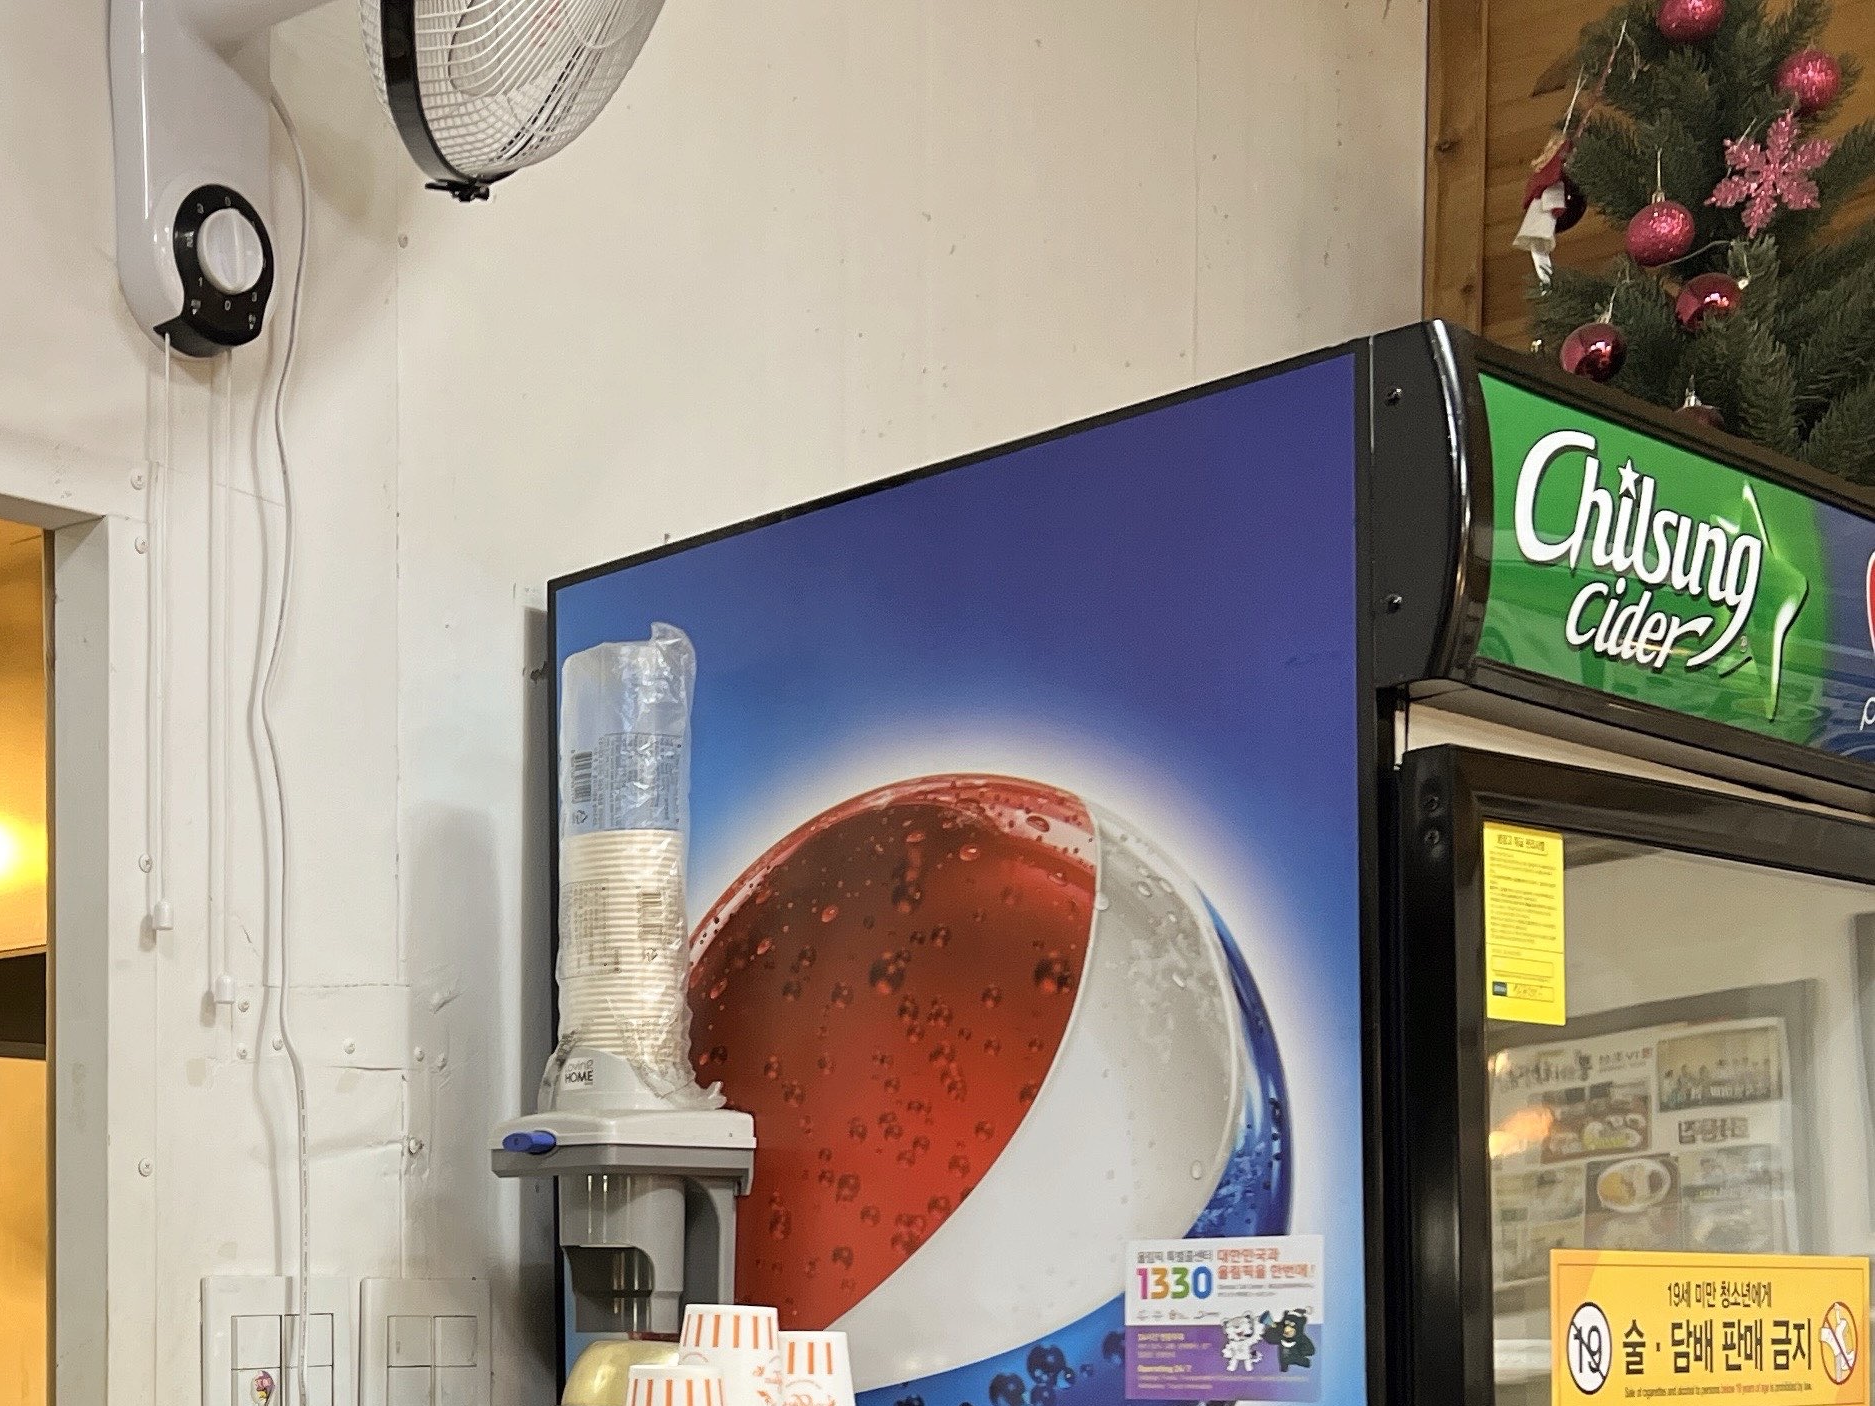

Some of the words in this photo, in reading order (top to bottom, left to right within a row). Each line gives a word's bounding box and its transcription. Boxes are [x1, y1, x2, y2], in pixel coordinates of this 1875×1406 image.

[1515, 429, 1763, 668] Chilsung
[1565, 578, 1713, 669] Cider
[1136, 1266, 1213, 1300] 1330
[1668, 1282, 1691, 1307] 19세
[1695, 1282, 1716, 1307] 미만
[1720, 1281, 1772, 1309] 청소년에게
[1573, 1325, 1603, 1374] 19
[1623, 1319, 1646, 1375] 술
[1671, 1319, 1714, 1373] 담배
[1722, 1319, 1763, 1372] 판매
[1770, 1318, 1812, 1371] 금지
